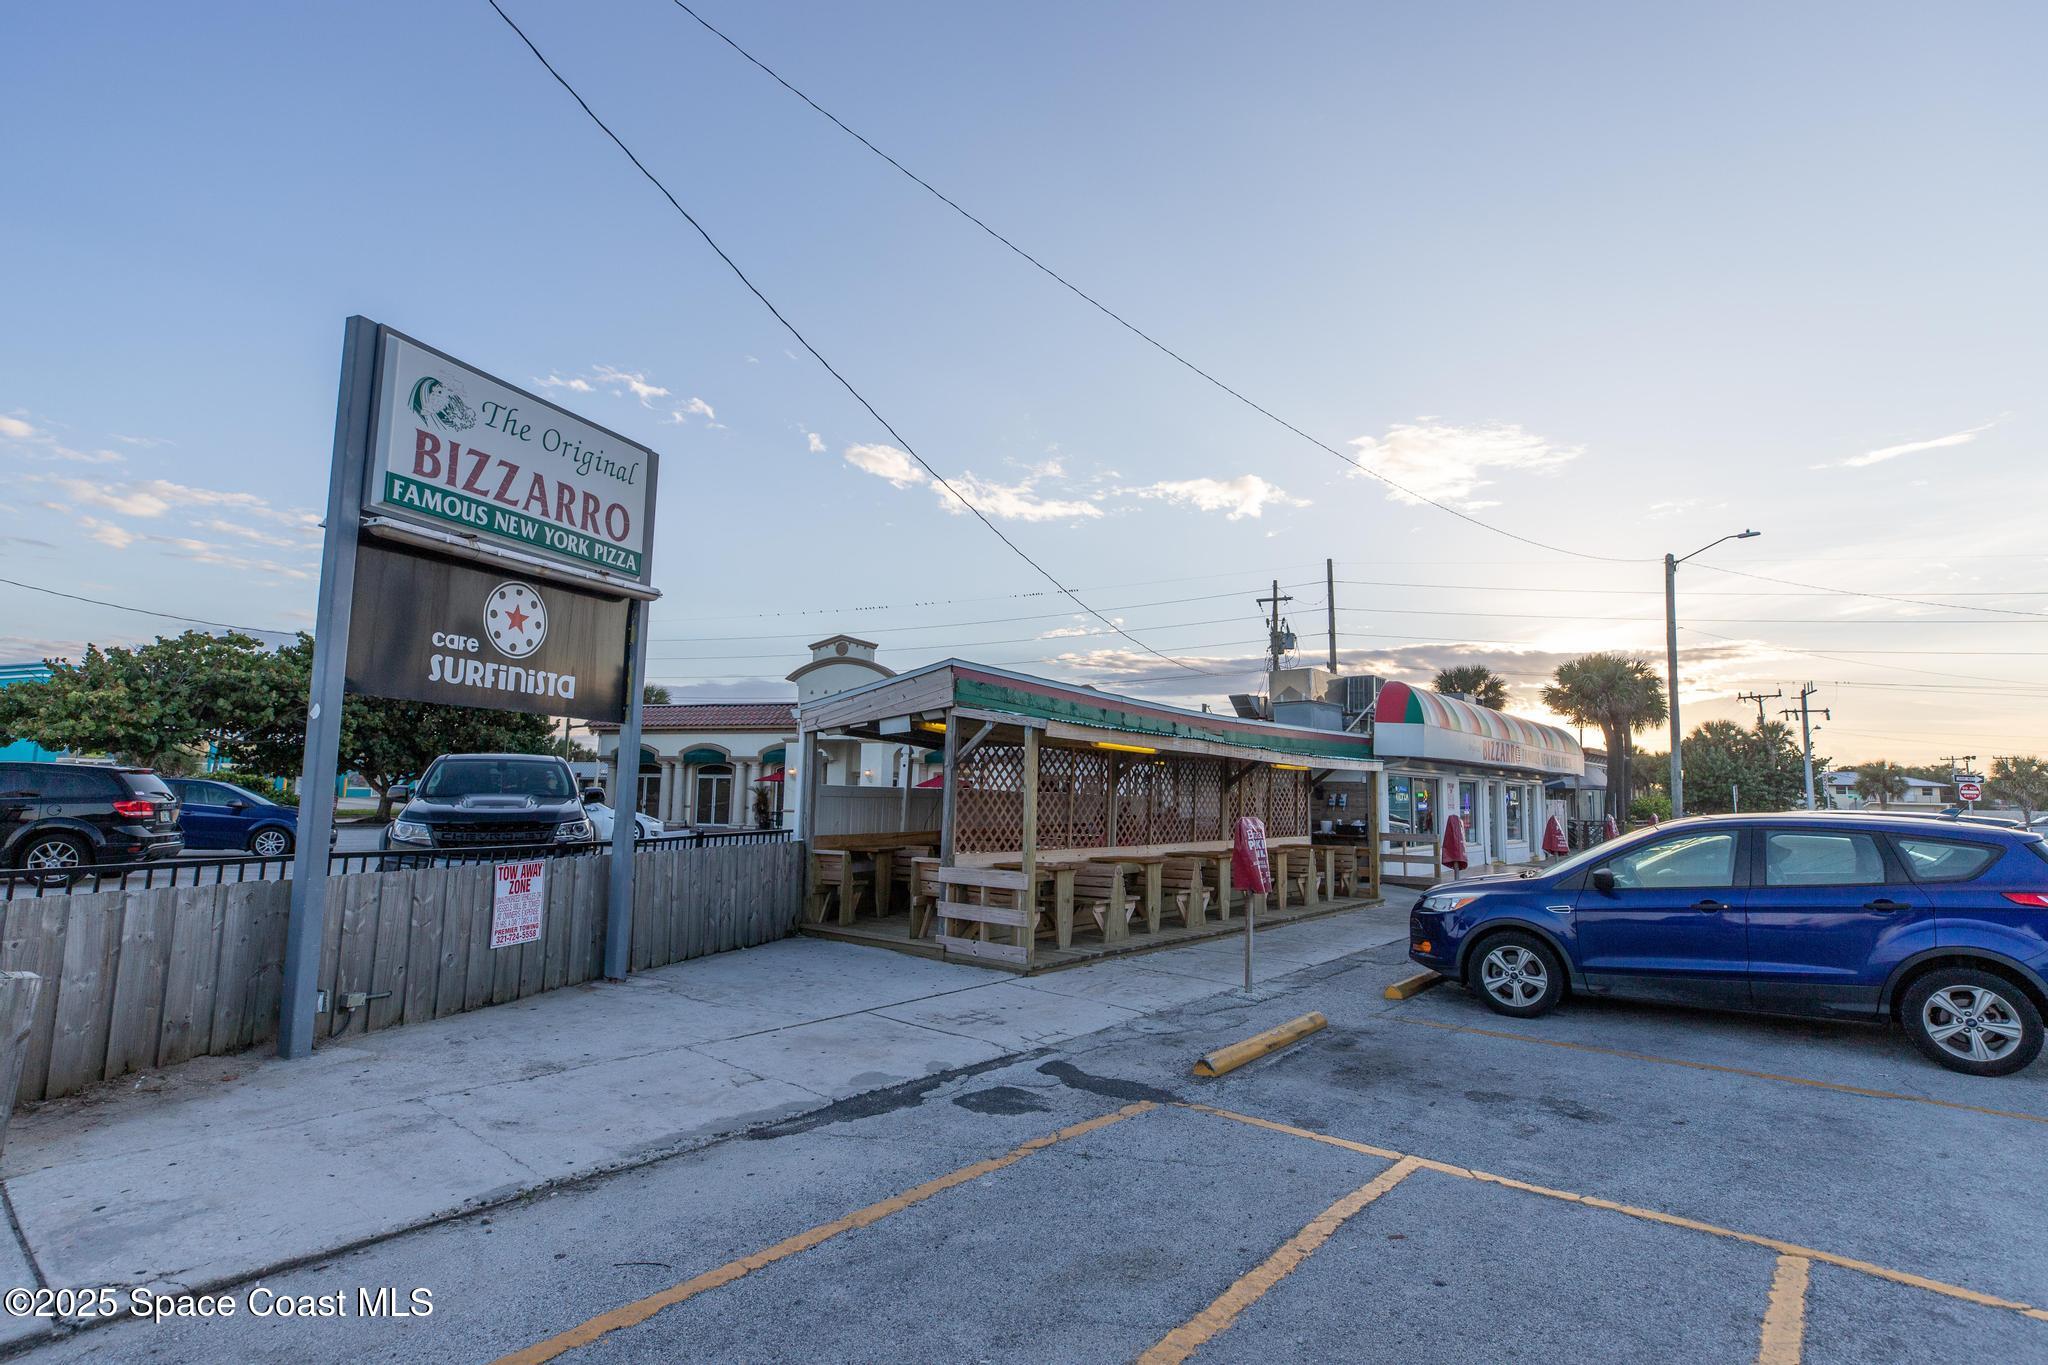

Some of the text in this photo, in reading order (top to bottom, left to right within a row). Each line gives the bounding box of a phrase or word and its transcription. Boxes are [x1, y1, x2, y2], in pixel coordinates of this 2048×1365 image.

[482, 400, 639, 485] The Original
[412, 428, 630, 542] BIZZARRO
[392, 478, 637, 571] FAMOUS NEW YORK PIZZA
[1482, 739, 1520, 765] BIZZARRO
[440, 832, 545, 841] CHEVROLET
[498, 863, 543, 881] TOW AWAY
[509, 879, 531, 894] ZONE
[494, 922, 540, 936] PREMIER TOWING
[495, 930, 537, 944] 321-724-5558
